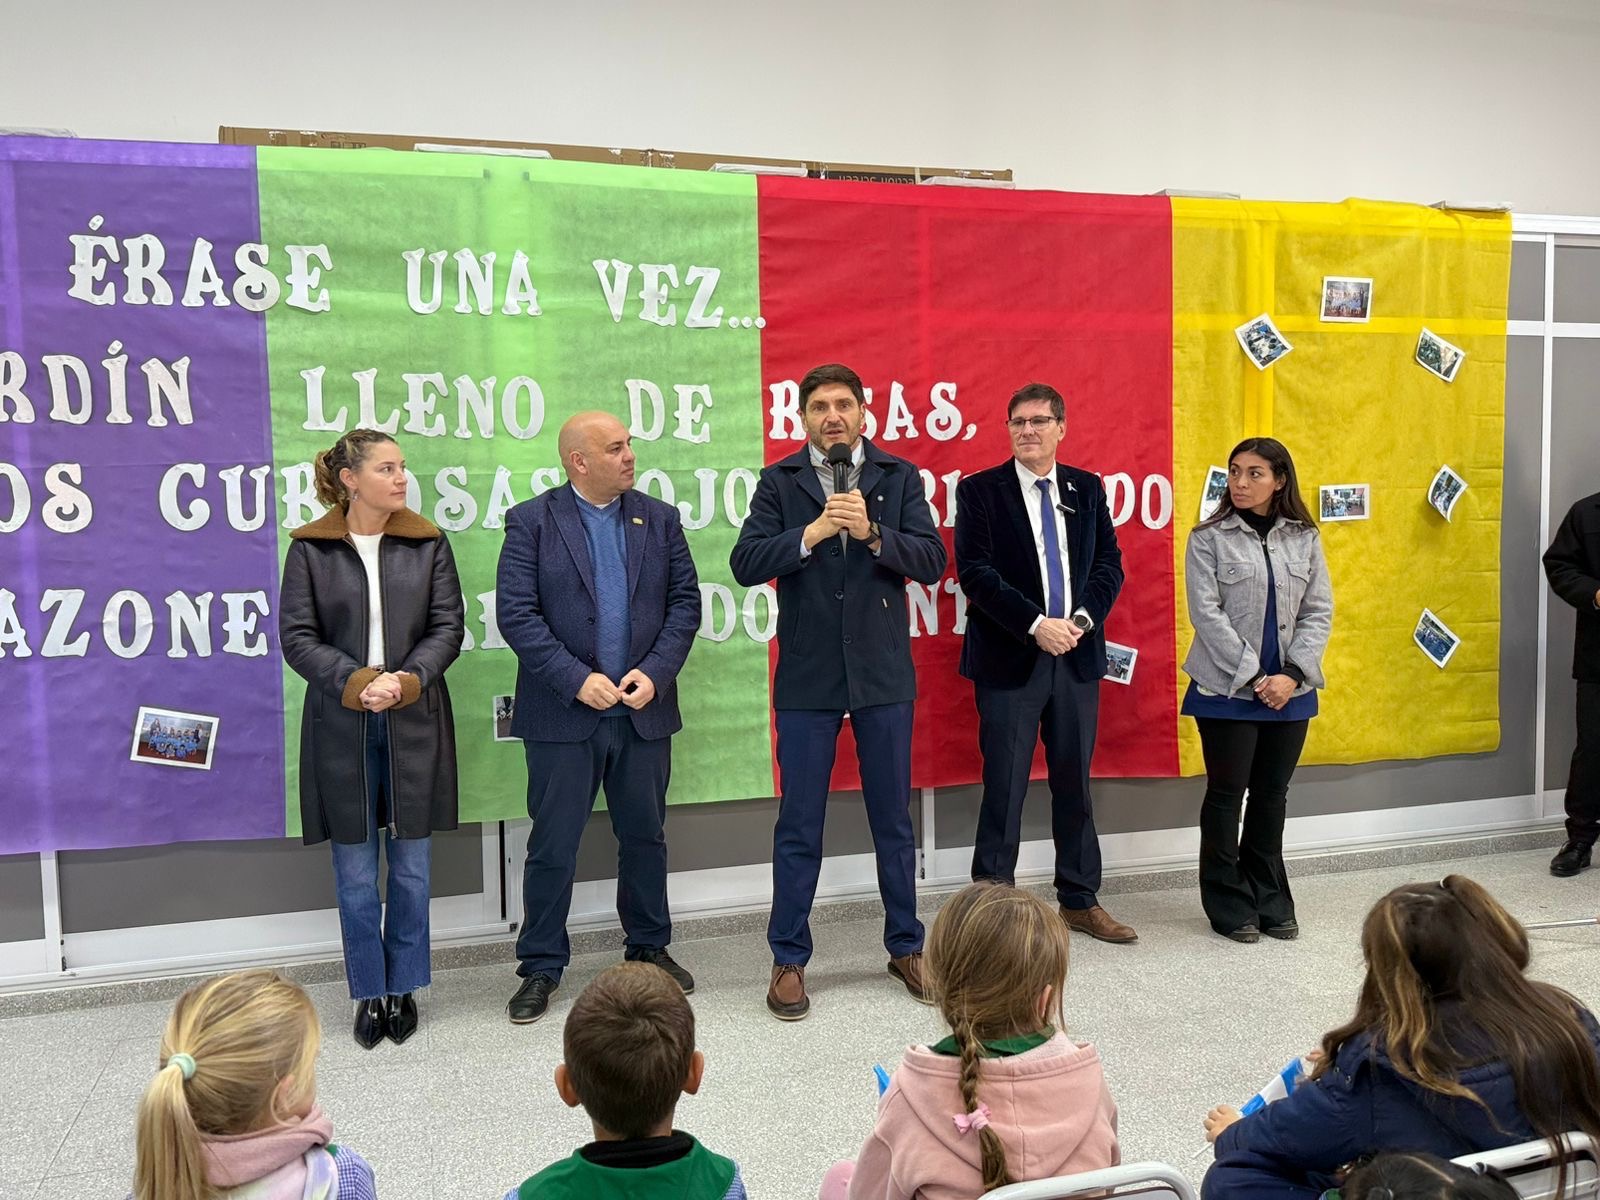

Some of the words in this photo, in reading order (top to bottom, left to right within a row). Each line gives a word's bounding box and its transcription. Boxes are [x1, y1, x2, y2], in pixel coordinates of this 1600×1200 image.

[68, 214, 333, 312] ÉRASE
[402, 248, 543, 316] UNA
[592, 258, 766, 329] VEZ...
[300, 366, 545, 440] LLENO
[625, 379, 713, 444] DE
